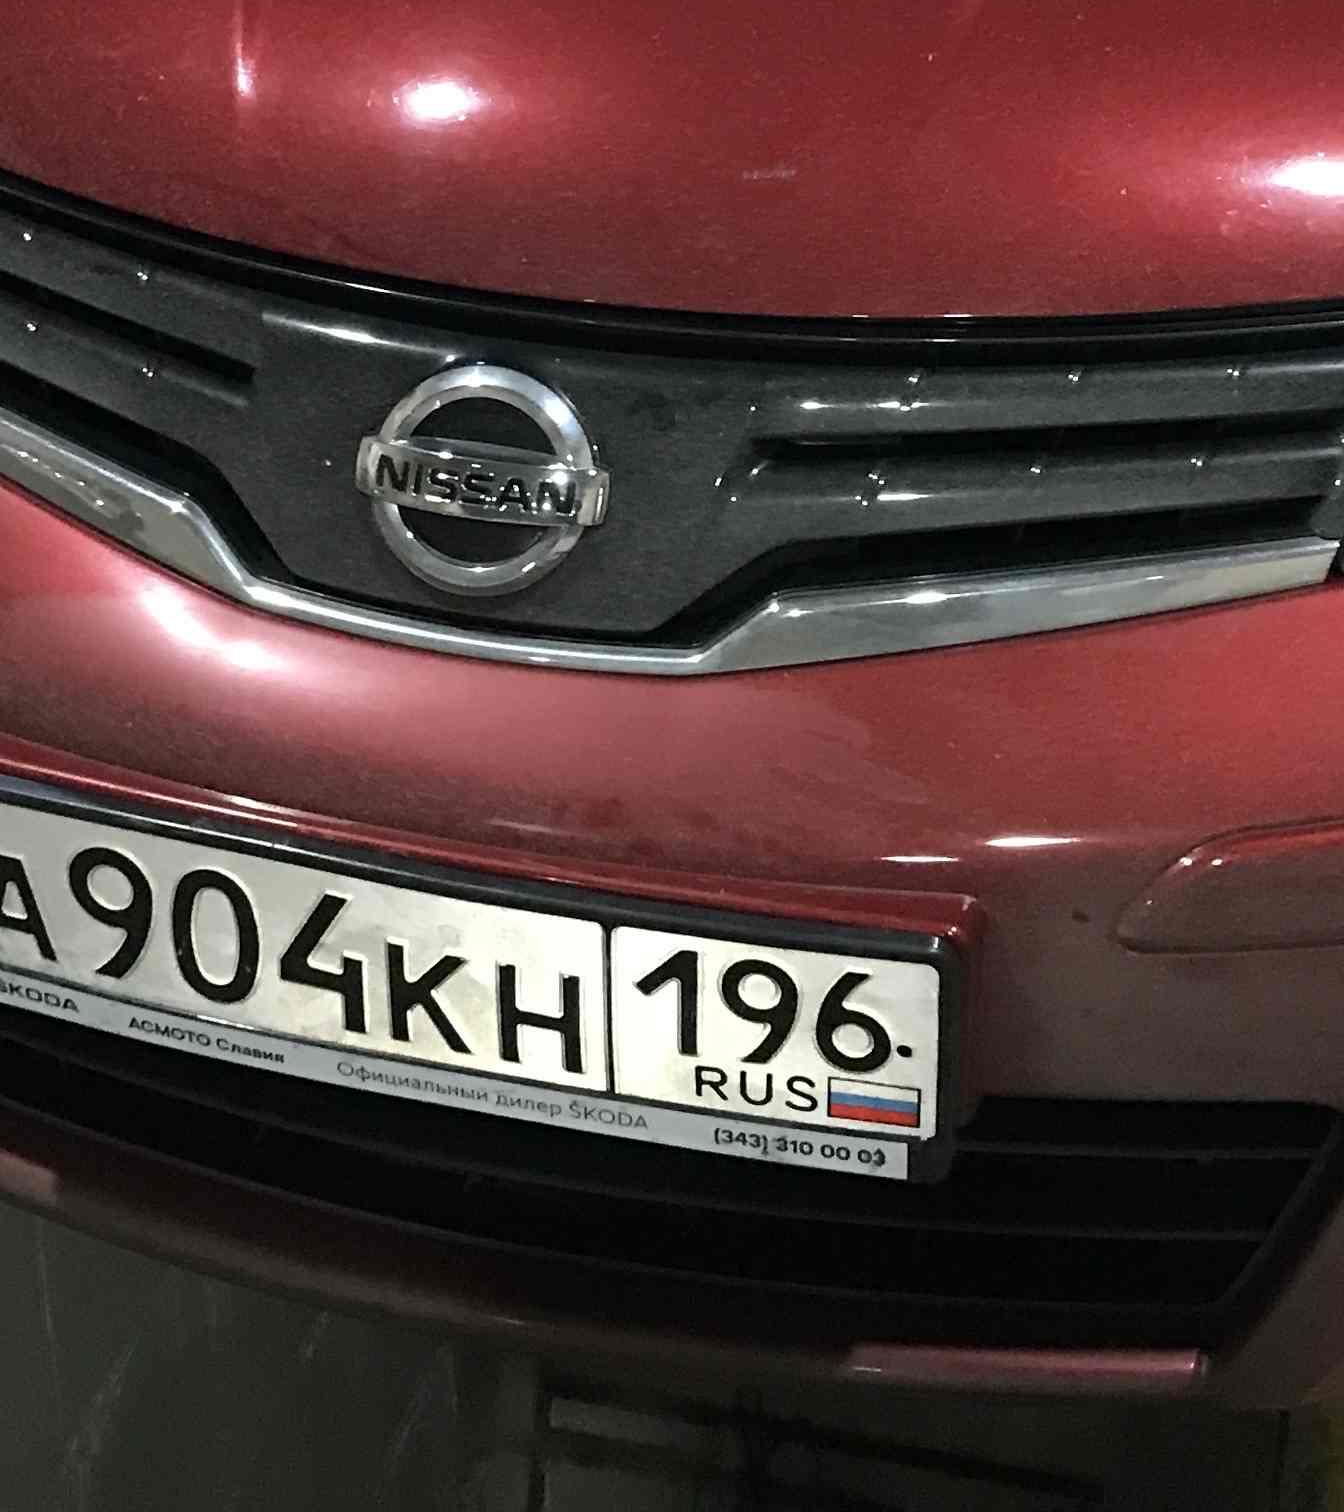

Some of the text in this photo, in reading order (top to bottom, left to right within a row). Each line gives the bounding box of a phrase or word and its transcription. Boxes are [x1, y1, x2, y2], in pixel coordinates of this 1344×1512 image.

[376, 453, 576, 516] NISSAN
[634, 949, 892, 1073] 196
[694, 1064, 819, 1113] RUS
[714, 1127, 768, 1154] (343)
[776, 1137, 814, 1156] 310
[820, 1143, 851, 1162] 00
